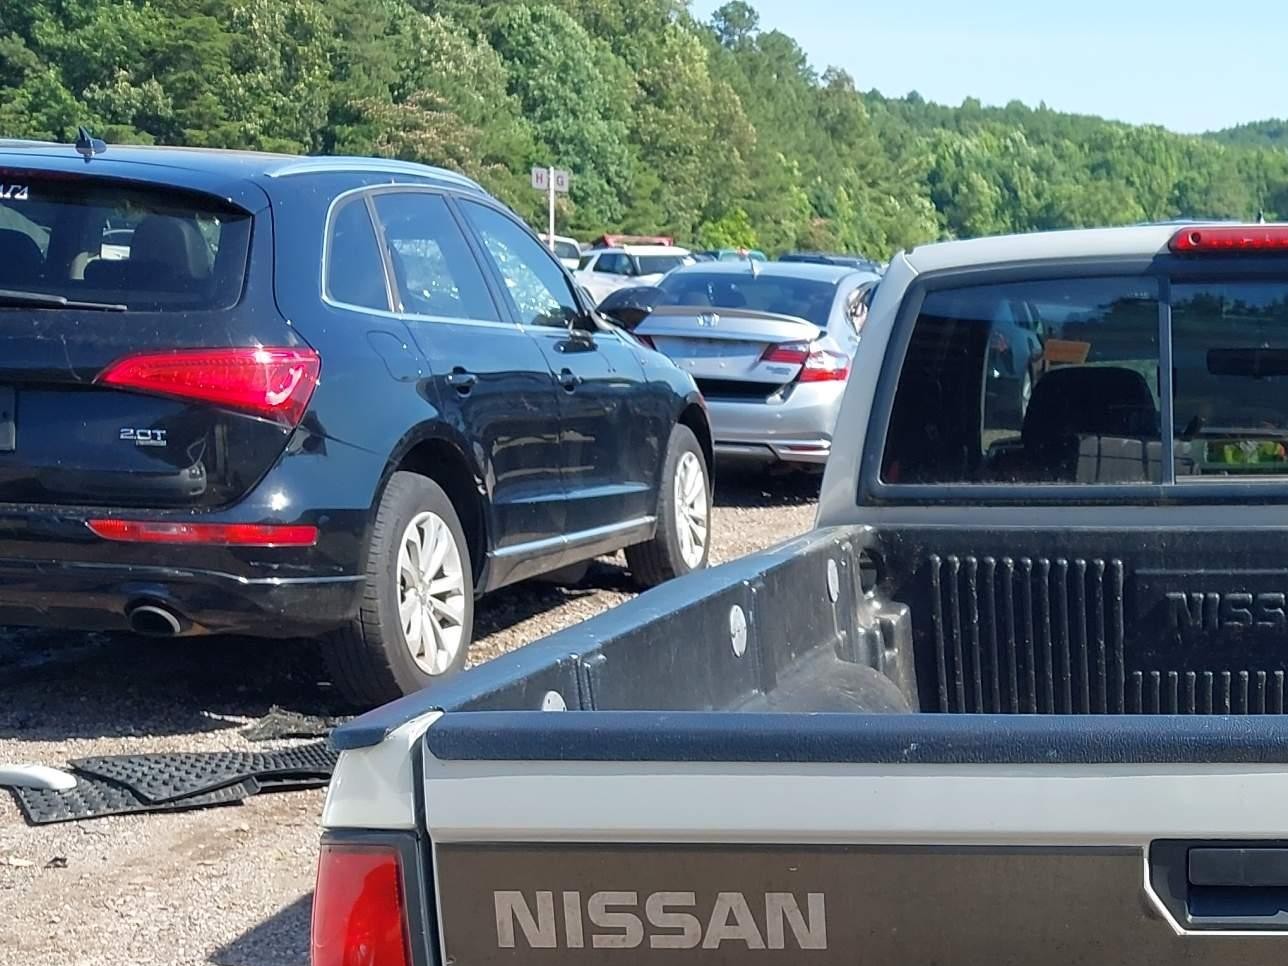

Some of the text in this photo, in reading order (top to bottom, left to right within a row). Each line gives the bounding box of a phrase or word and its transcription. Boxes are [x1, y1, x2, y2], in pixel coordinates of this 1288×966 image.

[535, 172, 564, 187] H G
[493, 890, 828, 950] NISSAN
